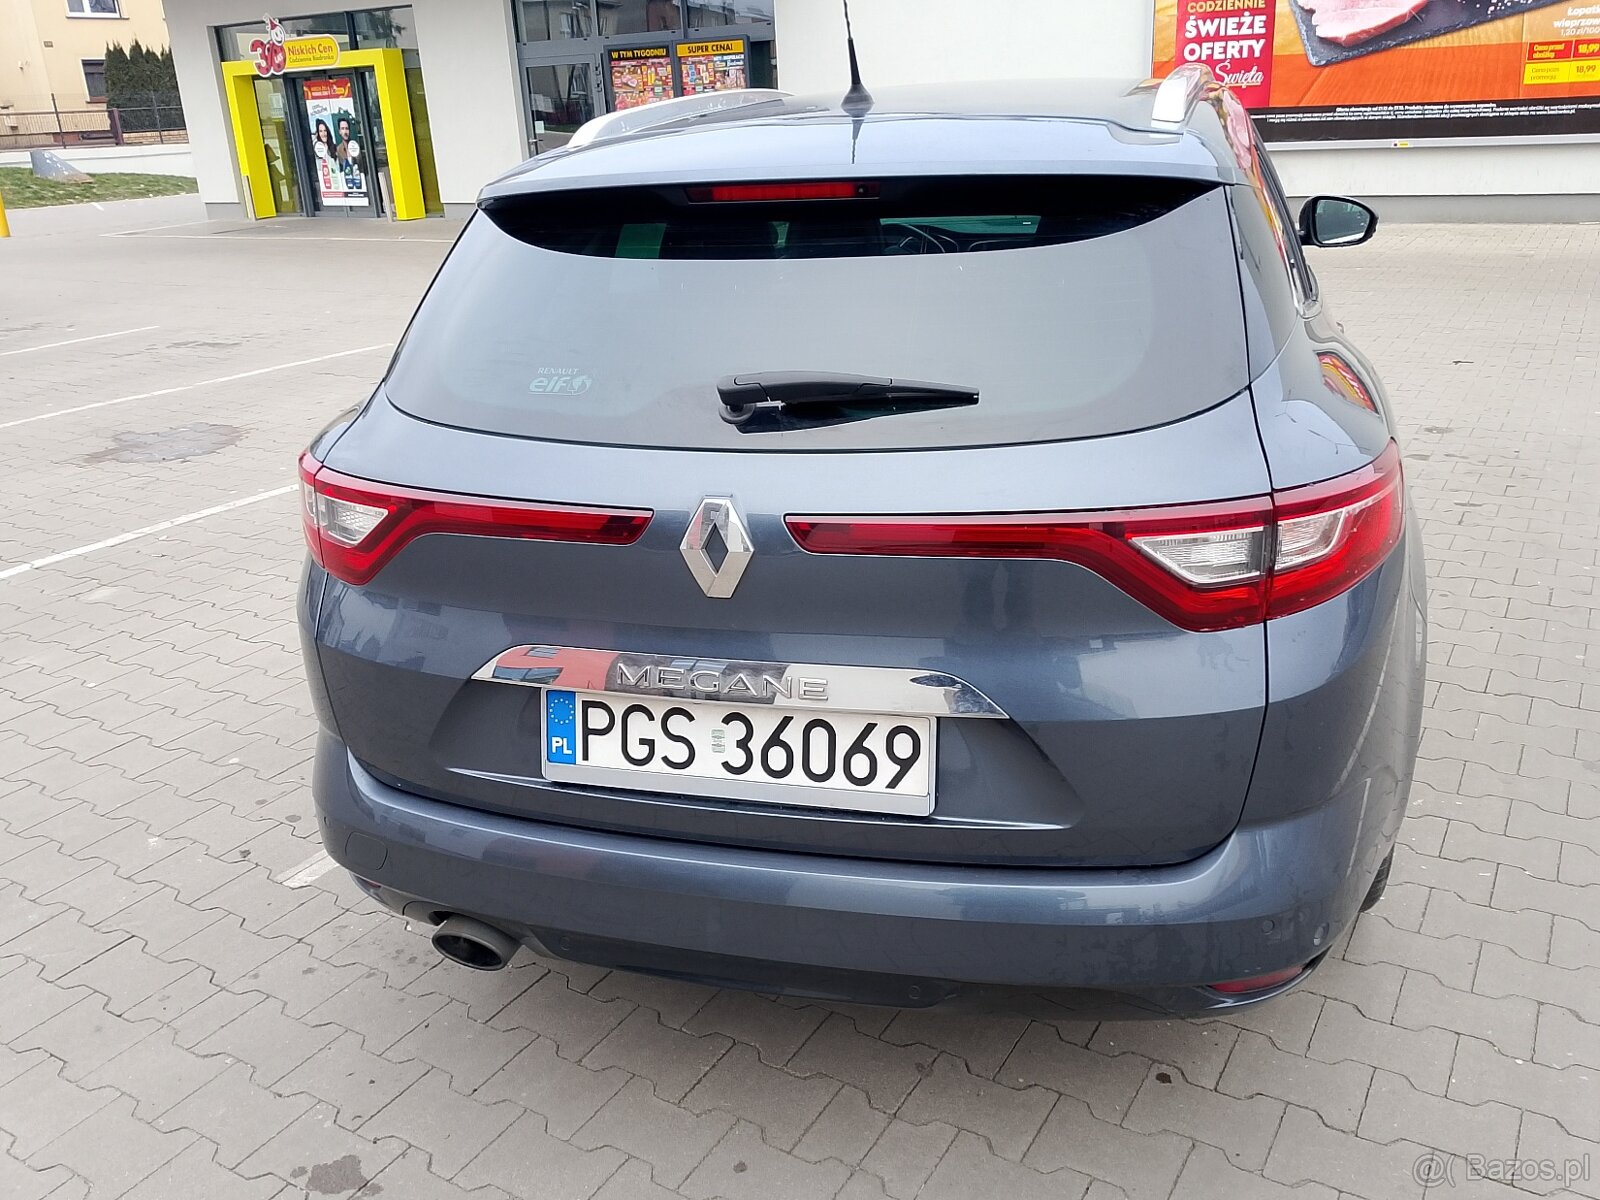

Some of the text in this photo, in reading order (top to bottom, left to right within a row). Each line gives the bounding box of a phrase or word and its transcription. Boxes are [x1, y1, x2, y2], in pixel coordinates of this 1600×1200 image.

[1187, 0, 1265, 13] CODZIENNIE
[1185, 11, 1266, 38] ŚWIEŻE
[288, 43, 333, 56] Niskich Cen
[611, 48, 667, 59] W TYM TYGODNIU
[687, 43, 734, 54] SUPER CENA!
[1183, 39, 1266, 61] OFERTY
[1215, 59, 1264, 88] Święta
[537, 367, 579, 375] RENAULT
[528, 376, 571, 393] elf
[616, 662, 829, 702] MEGANE
[551, 736, 573, 755] PL
[581, 699, 922, 789] PGS 36069
